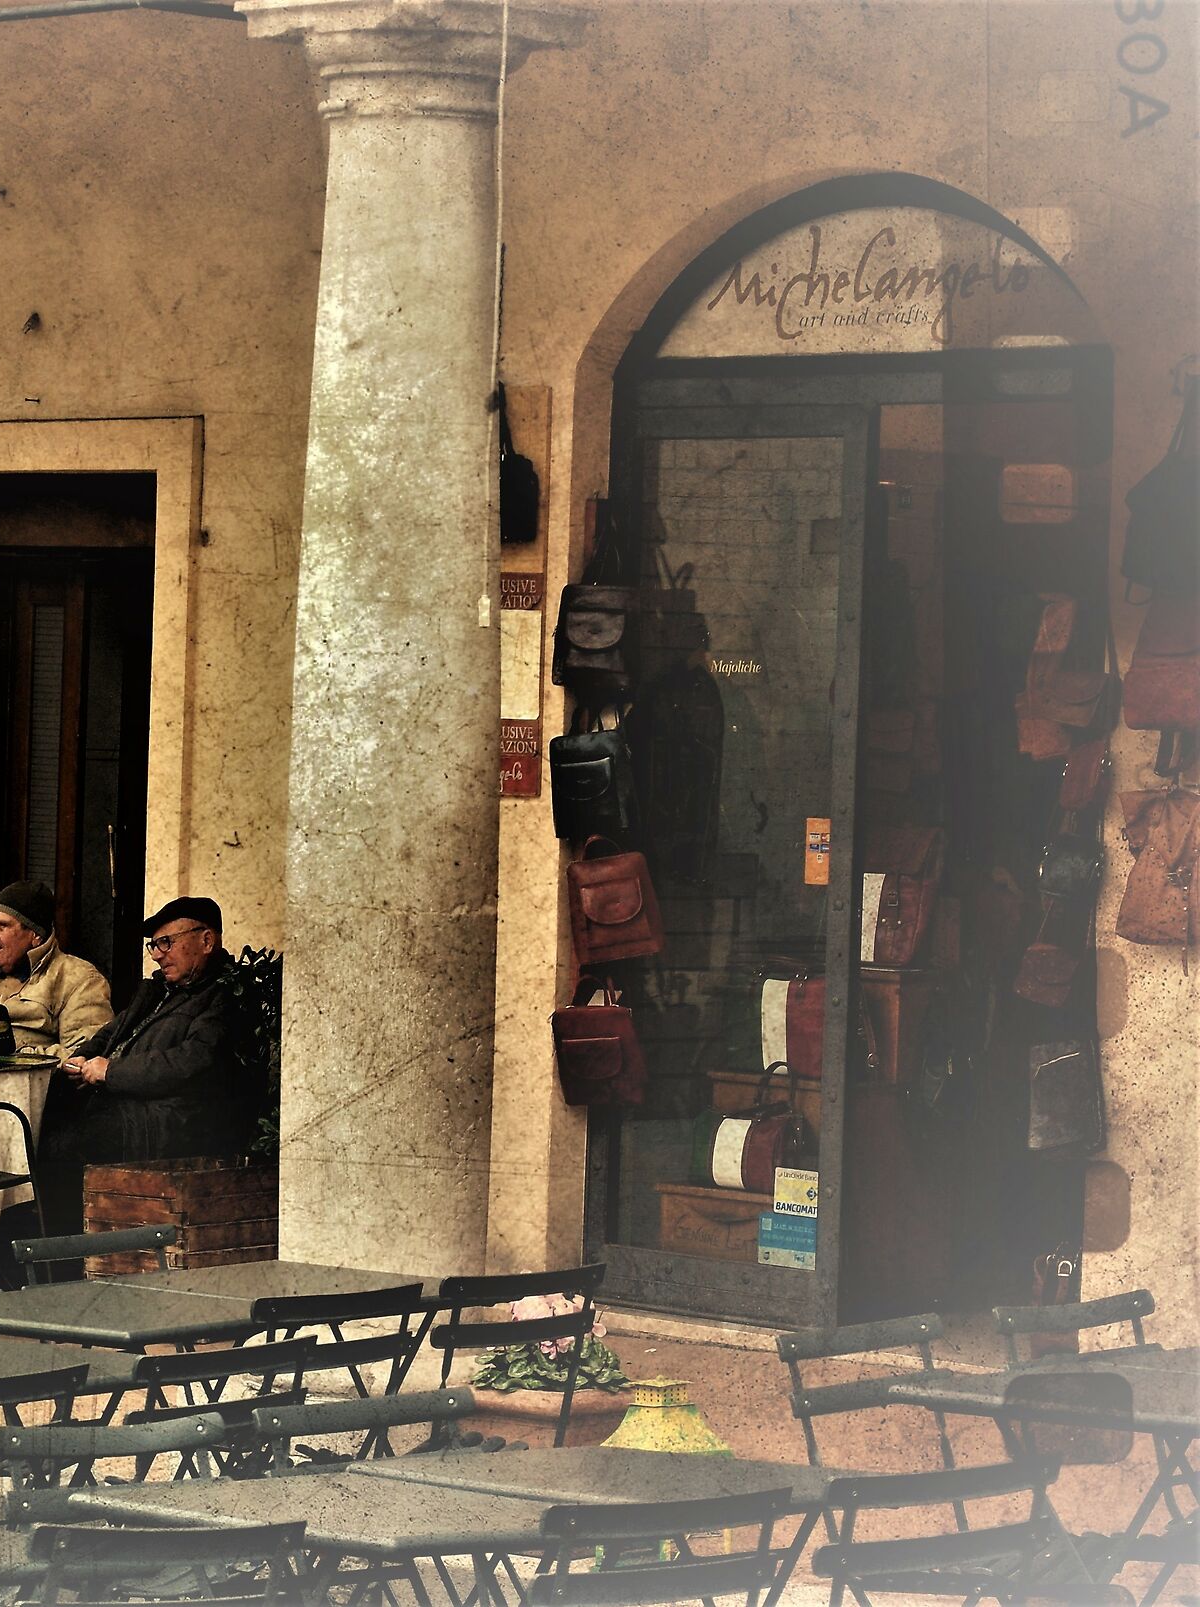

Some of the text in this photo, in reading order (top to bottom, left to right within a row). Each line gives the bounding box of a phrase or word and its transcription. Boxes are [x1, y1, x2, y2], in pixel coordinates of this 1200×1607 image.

[799, 303, 930, 328] art and crafts
[500, 595, 540, 608] ATION
[710, 660, 762, 677] Majoliche
[776, 1201, 817, 1215] BANCOMAT
